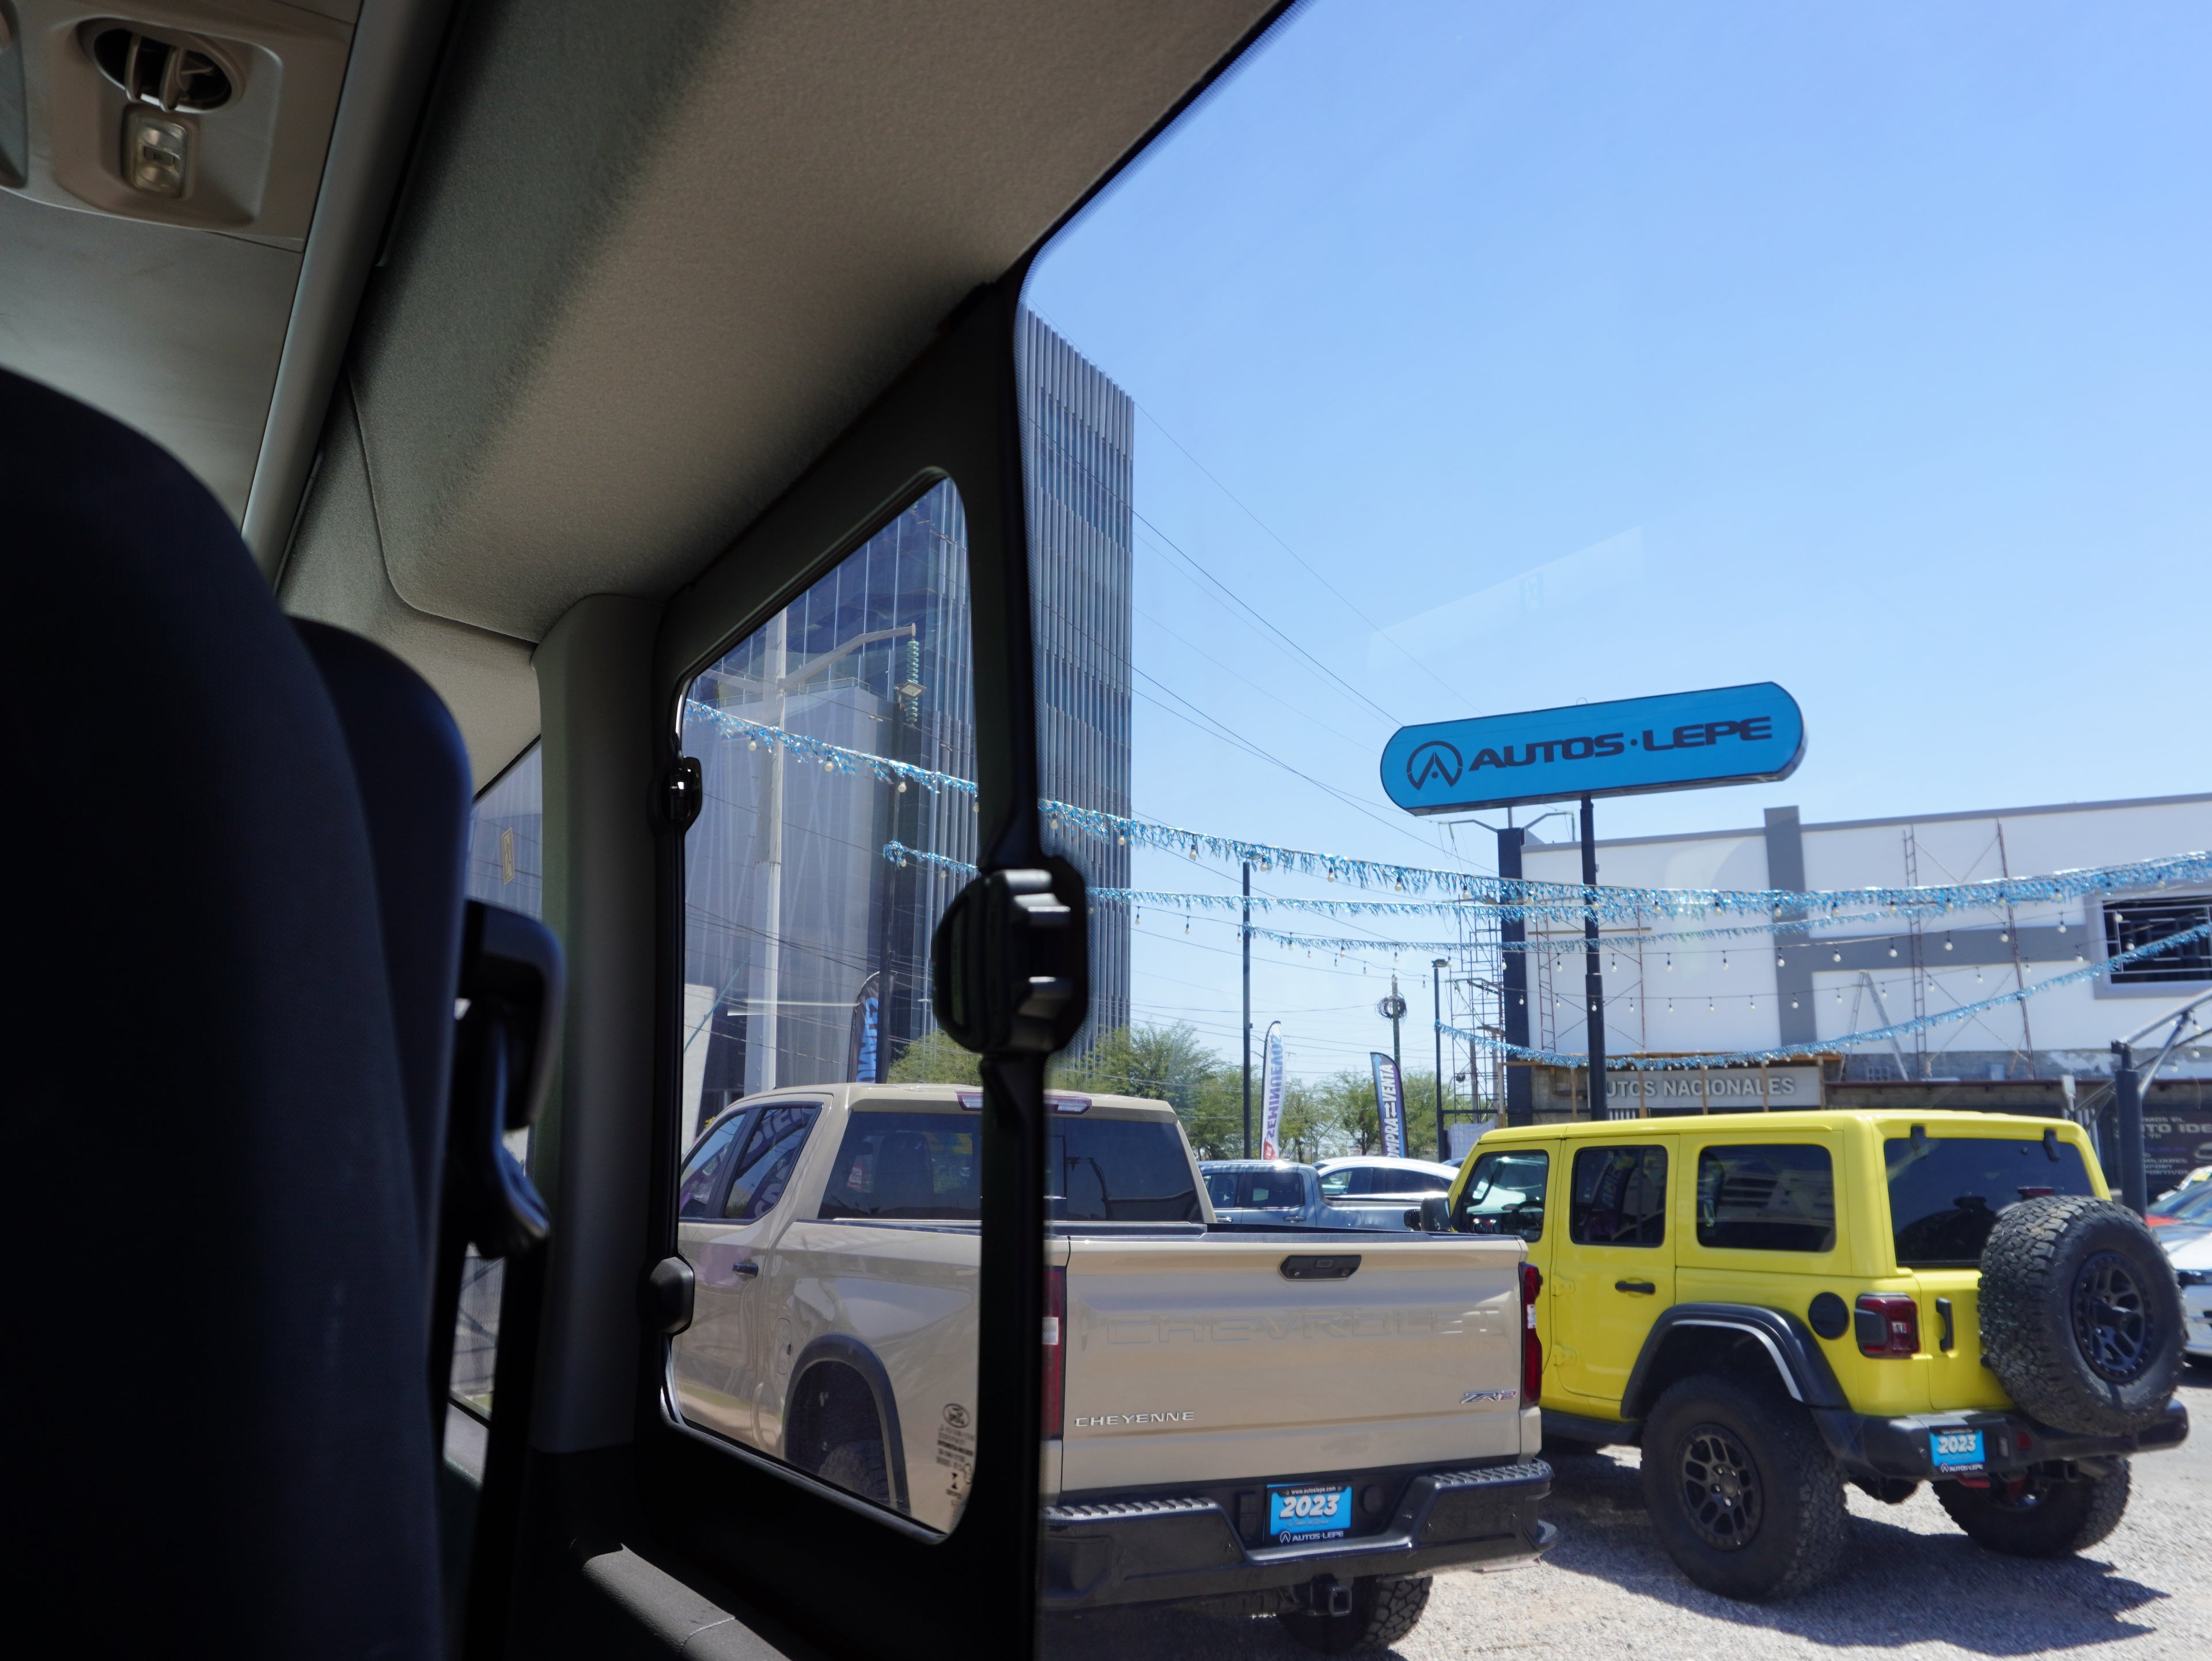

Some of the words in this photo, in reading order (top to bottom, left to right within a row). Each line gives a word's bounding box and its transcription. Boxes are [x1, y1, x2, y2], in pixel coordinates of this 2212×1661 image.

[1379, 1064, 1397, 1102] VENTA
[1607, 1080, 1656, 1098] UTOS
[1663, 1077, 1796, 1097] NACIONALES
[1384, 1118, 1401, 1158] OMPRA
[1460, 1388, 1518, 1404] ZR2
[1074, 1411, 1194, 1427] CHEYENNE
[1938, 1435, 1977, 1454] 2023
[1291, 1486, 1336, 1494] www.autoslepe.com
[1279, 1494, 1341, 1518] 2023
